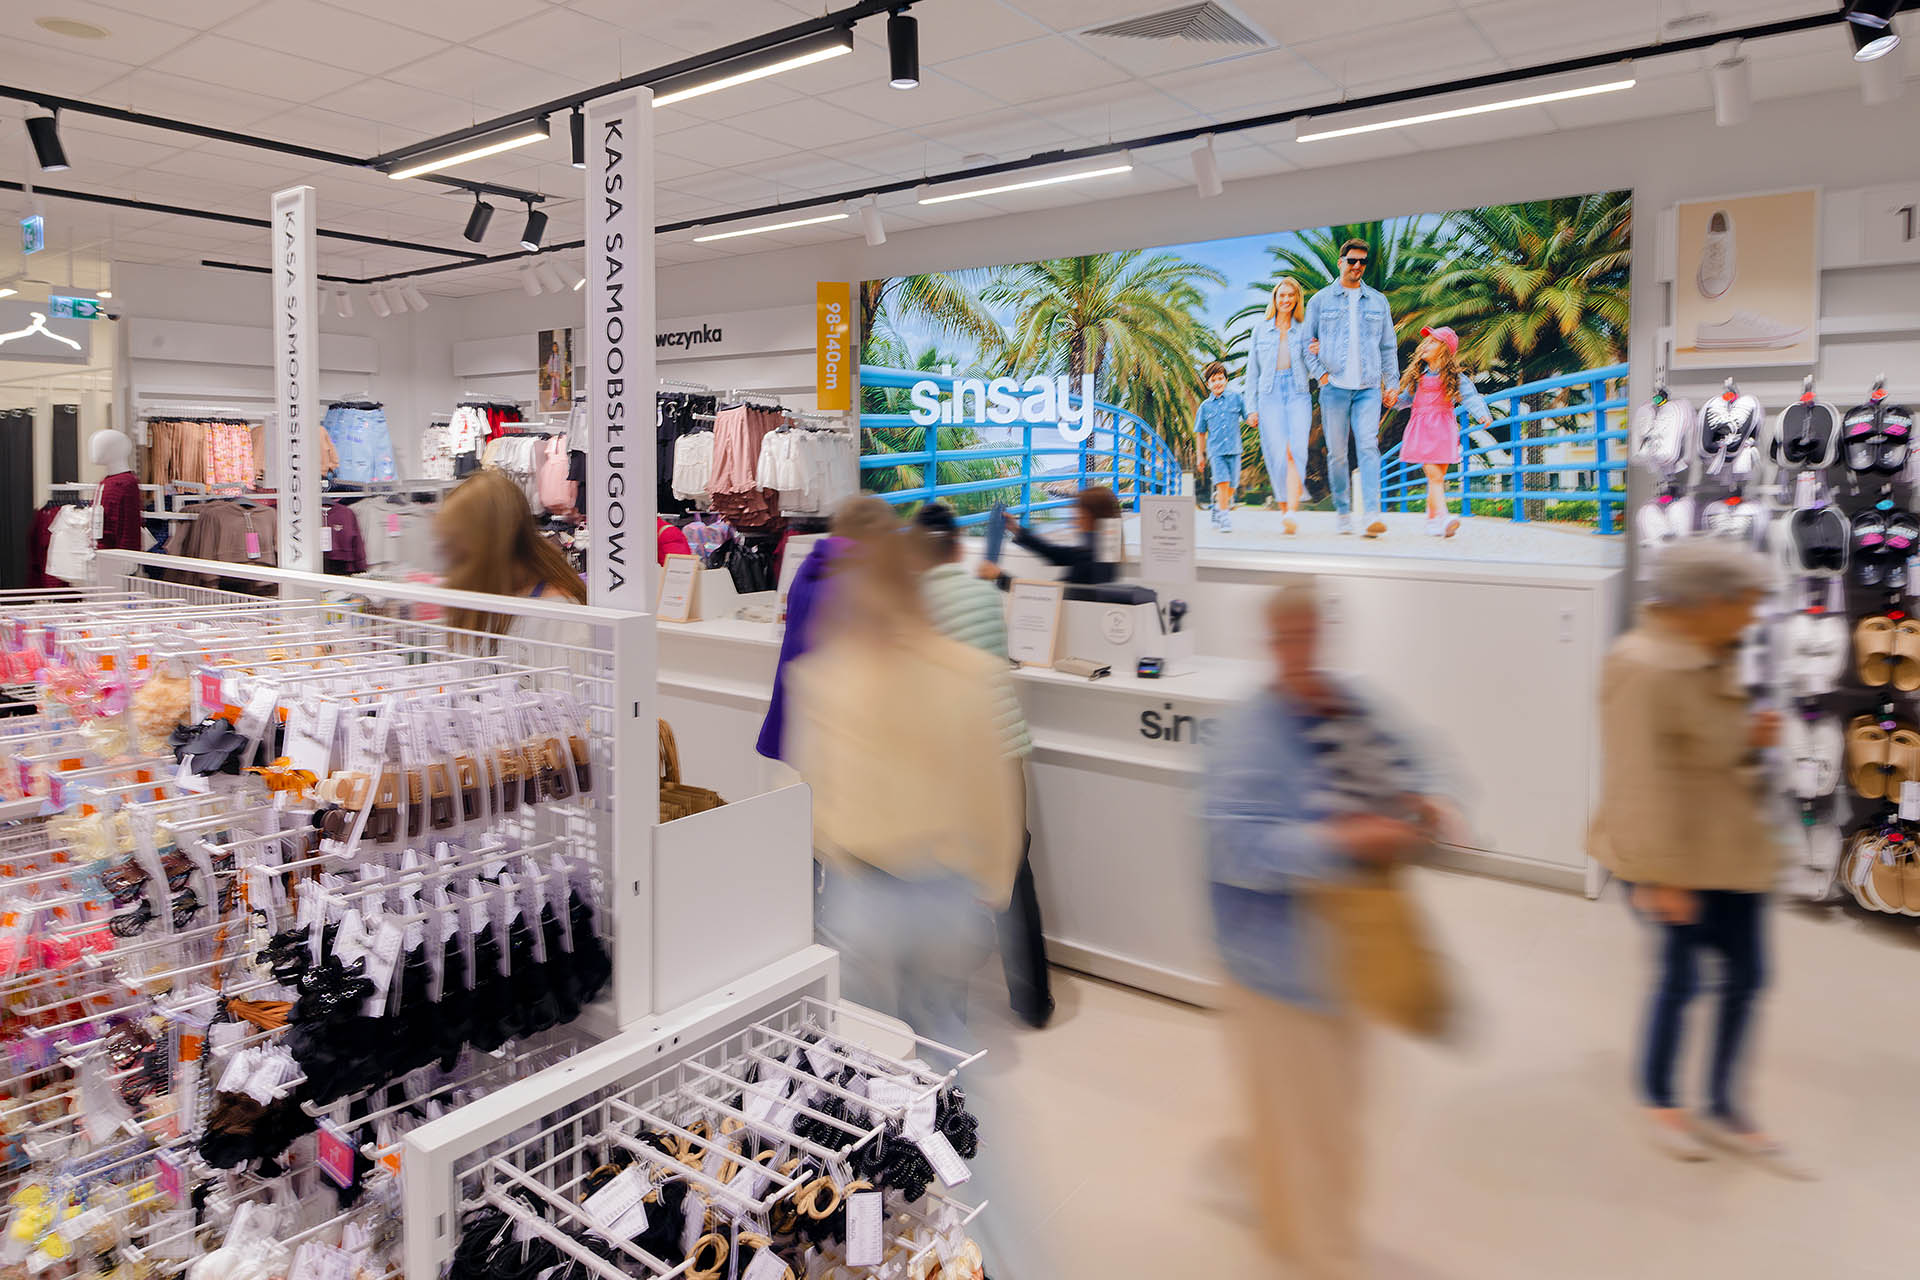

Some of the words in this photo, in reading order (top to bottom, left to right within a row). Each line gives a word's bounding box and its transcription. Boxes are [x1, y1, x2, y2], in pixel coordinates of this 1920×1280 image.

[605, 118, 624, 224] KASA
[284, 210, 297, 289] KASA
[825, 302, 842, 390] 98-140cm
[605, 232, 626, 593] SAMOOBSŁUGOWA
[909, 363, 1096, 443] sinsay
